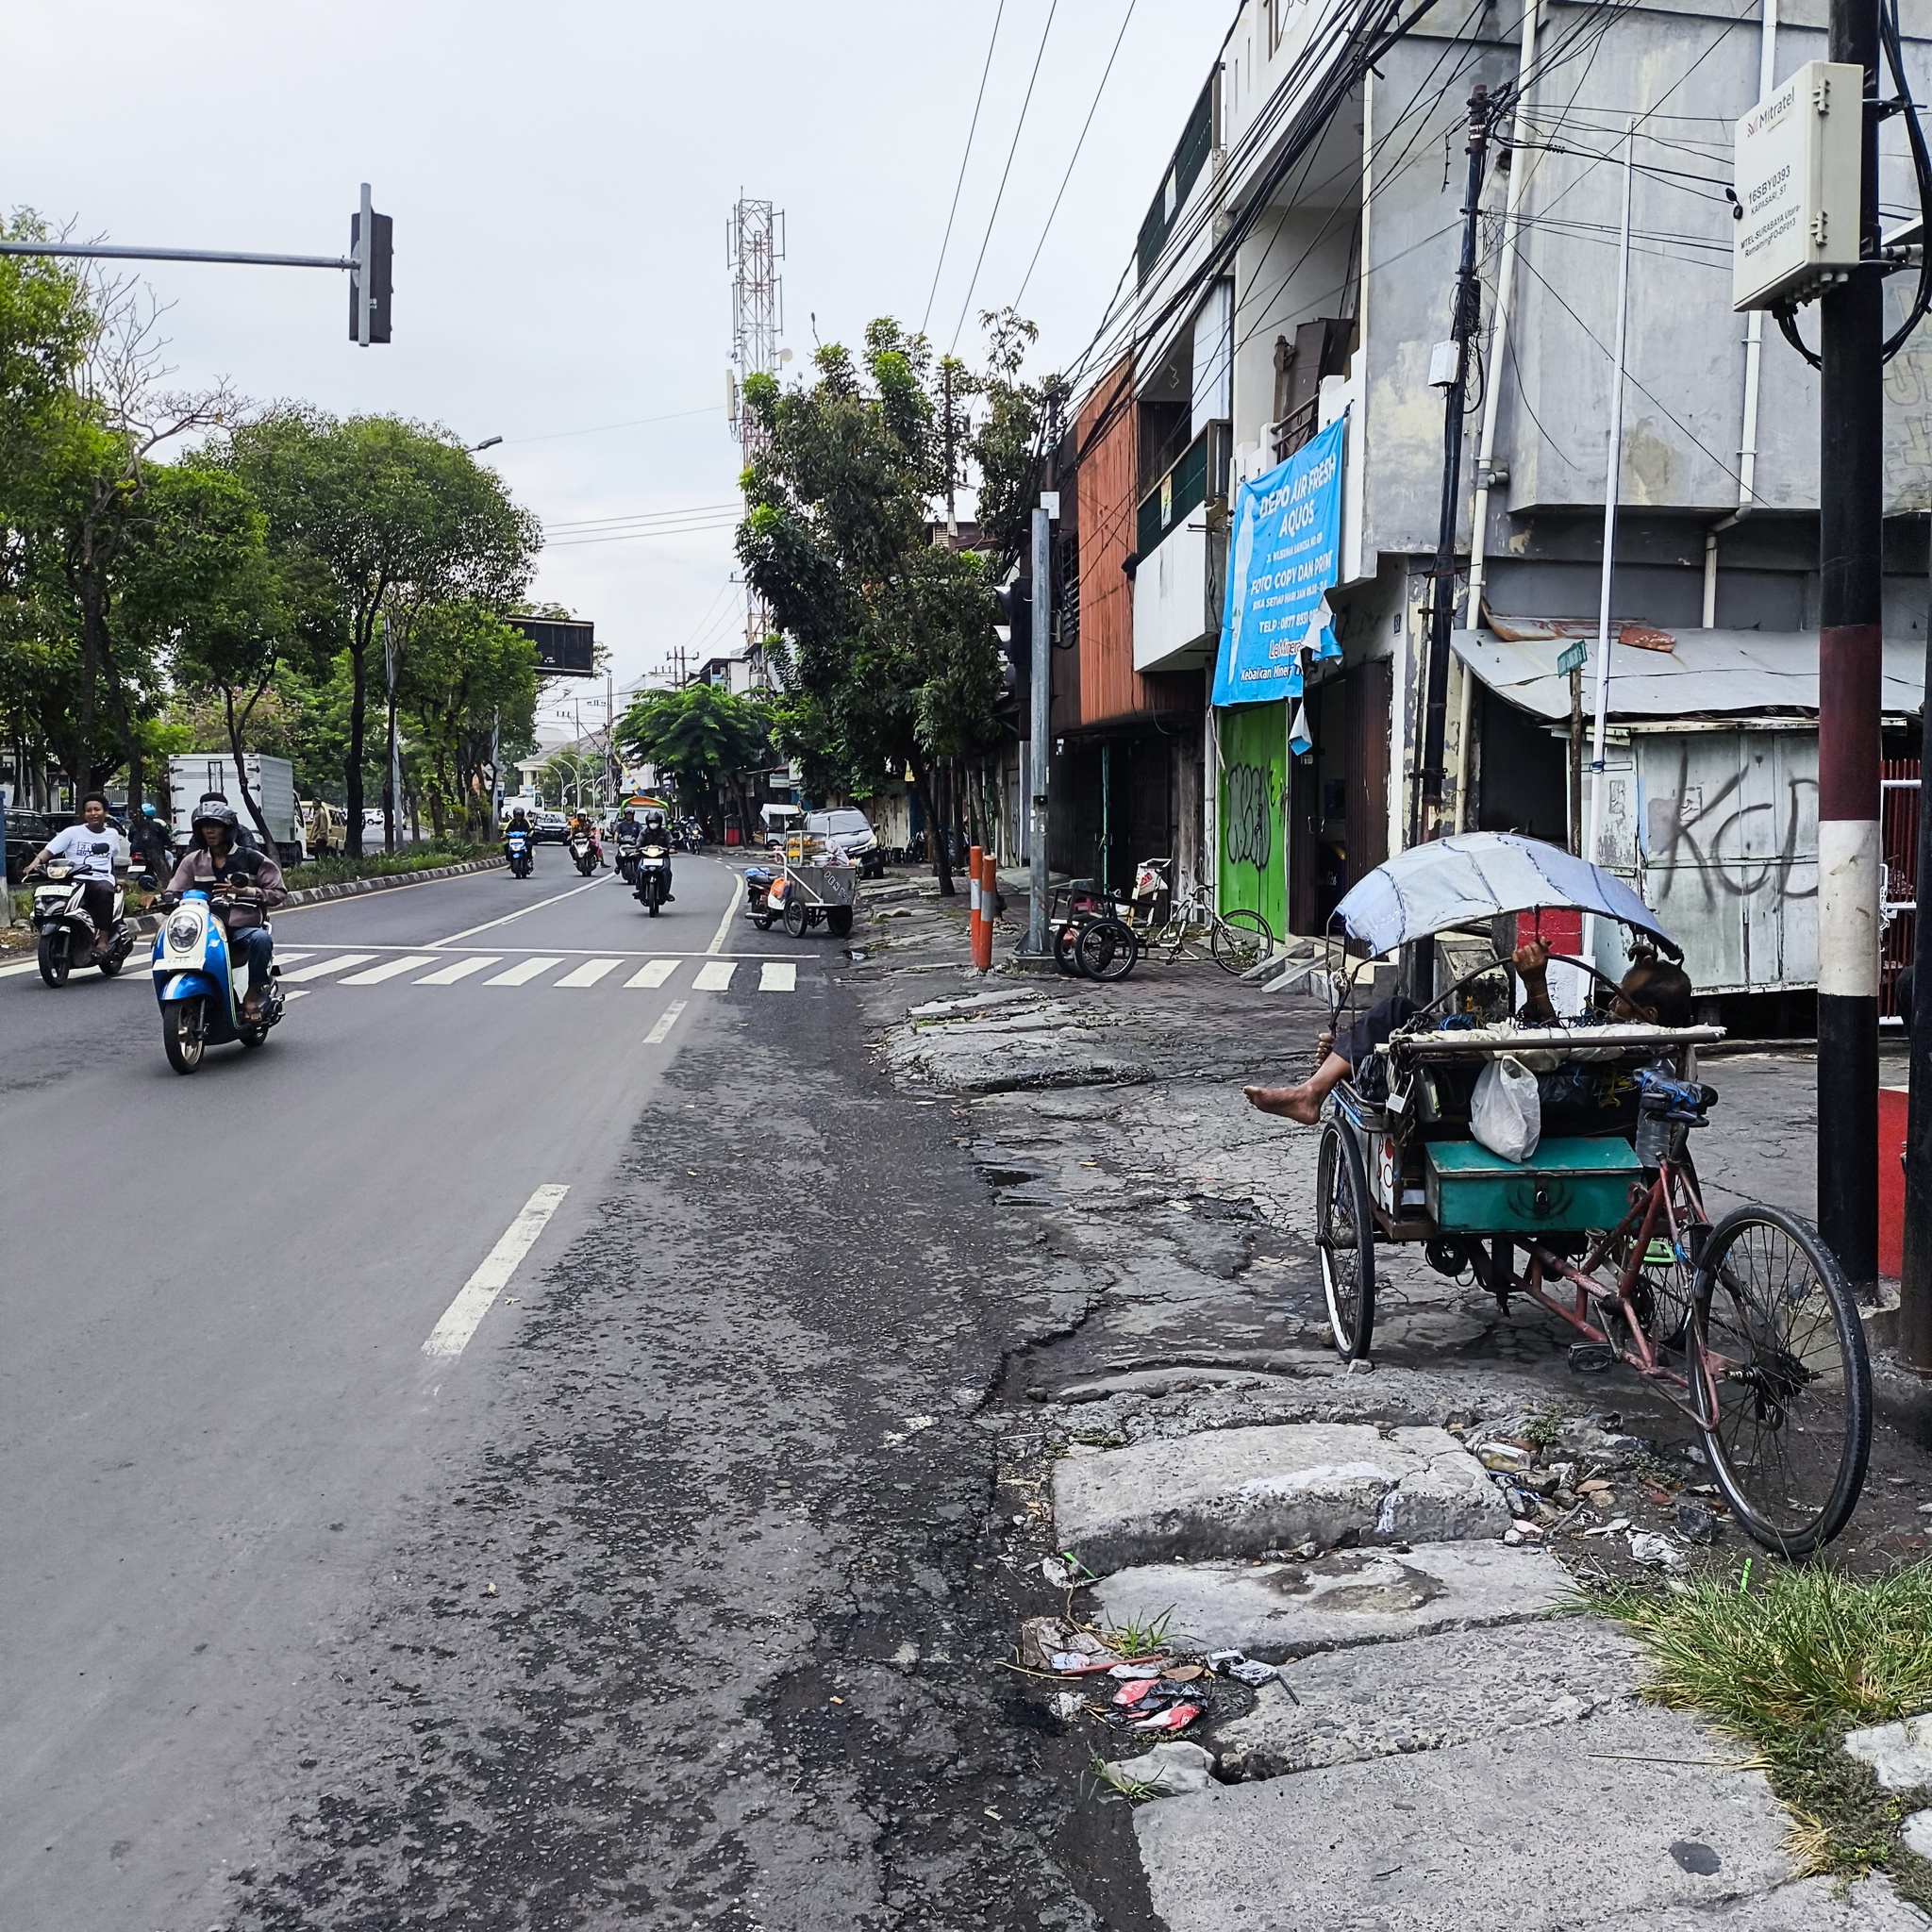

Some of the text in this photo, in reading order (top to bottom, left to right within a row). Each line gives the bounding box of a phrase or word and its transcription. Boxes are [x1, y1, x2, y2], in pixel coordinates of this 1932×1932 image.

[1759, 86, 1794, 128] Mitratel
[1748, 164, 1790, 205] 16SBY0393
[1750, 184, 1787, 215] KAPASARI_ST
[1740, 214, 1784, 250] MTEL-SURABAYA
[1259, 453, 1337, 519] DEPO AIR FRESH
[1278, 499, 1315, 538] AQUOS
[1250, 575, 1273, 595] FOTO
[1274, 566, 1298, 590] COPY
[1297, 558, 1315, 581] DAN
[1314, 549, 1334, 575] PRINT
[1258, 619, 1277, 634] TELP
[824, 870, 852, 904] PENTOL
